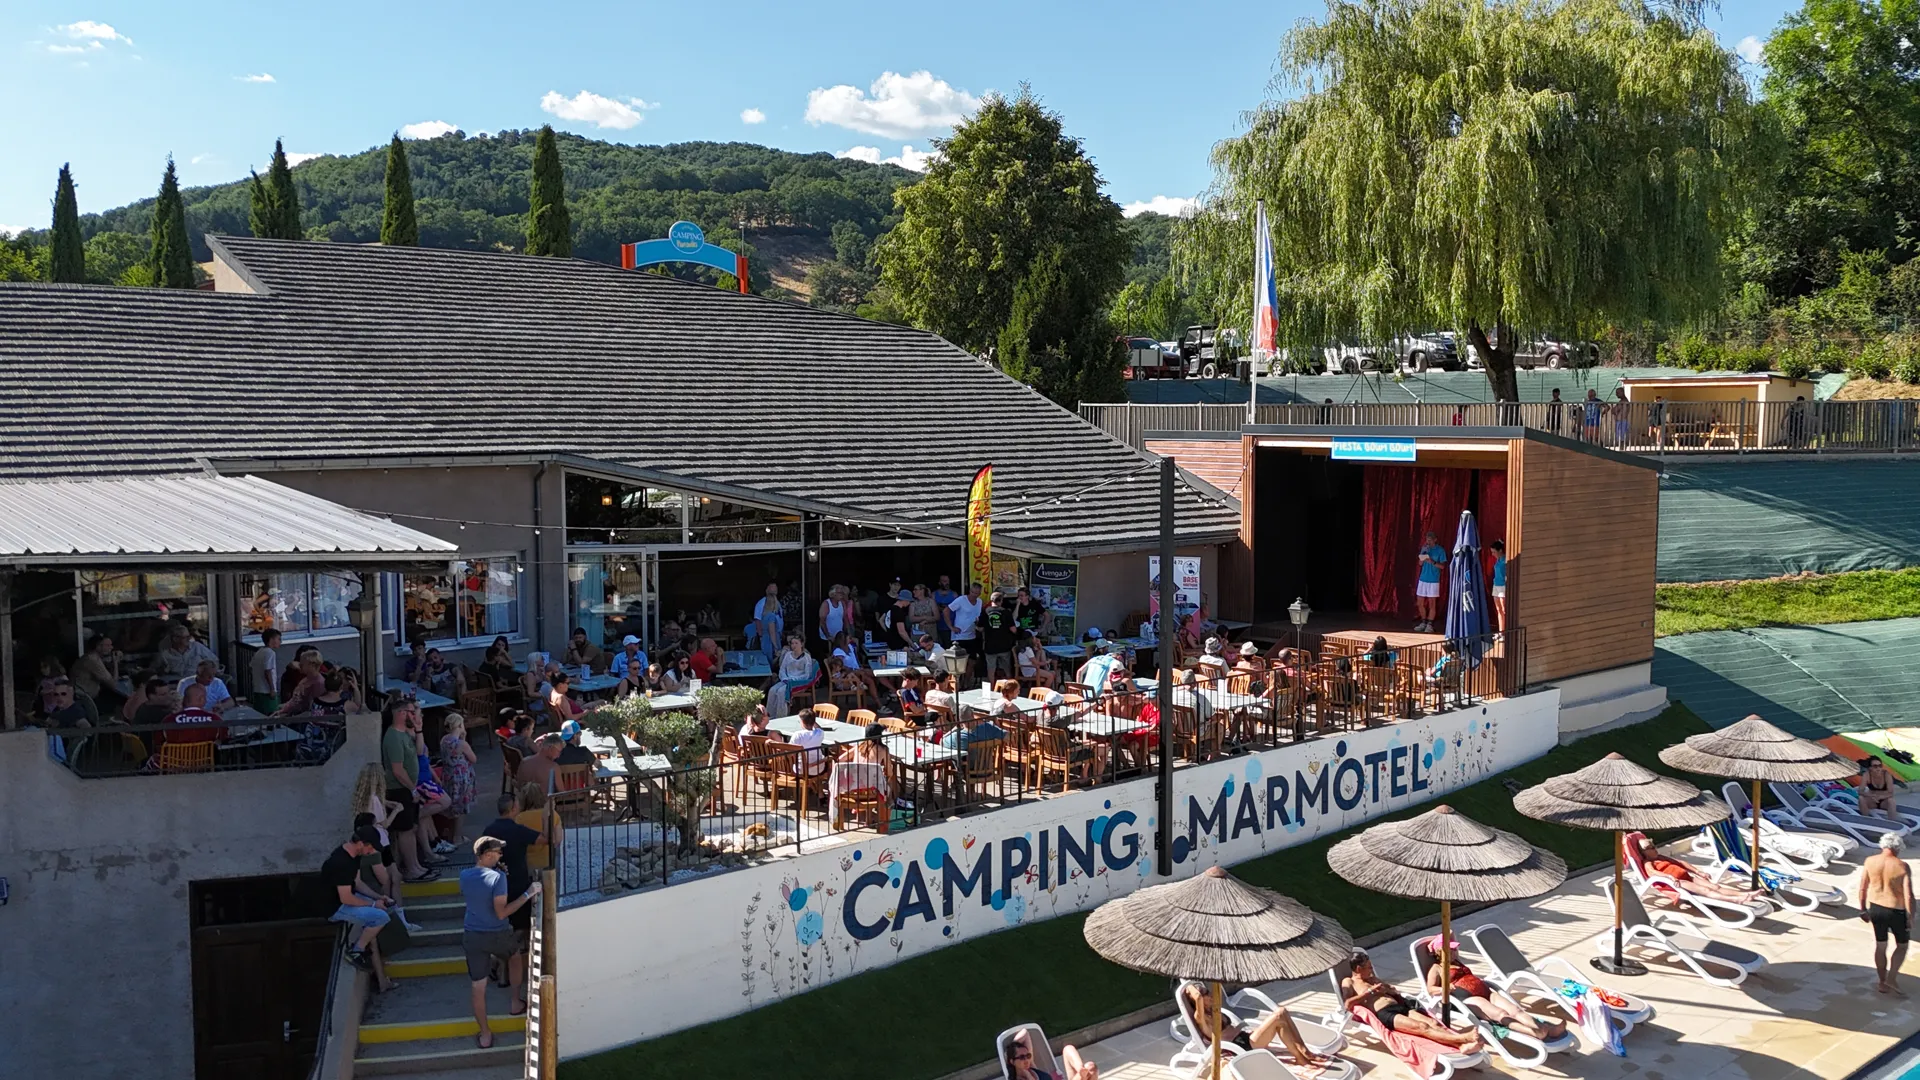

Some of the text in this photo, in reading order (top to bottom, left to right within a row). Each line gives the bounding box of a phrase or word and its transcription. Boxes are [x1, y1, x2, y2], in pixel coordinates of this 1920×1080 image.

[672, 231, 702, 240] CAMPING
[1335, 442, 1362, 452] FIESTA
[1183, 576, 1198, 584] BASE
[175, 714, 212, 723] Circus
[842, 742, 1428, 941] CAMPING MARMOTEL
